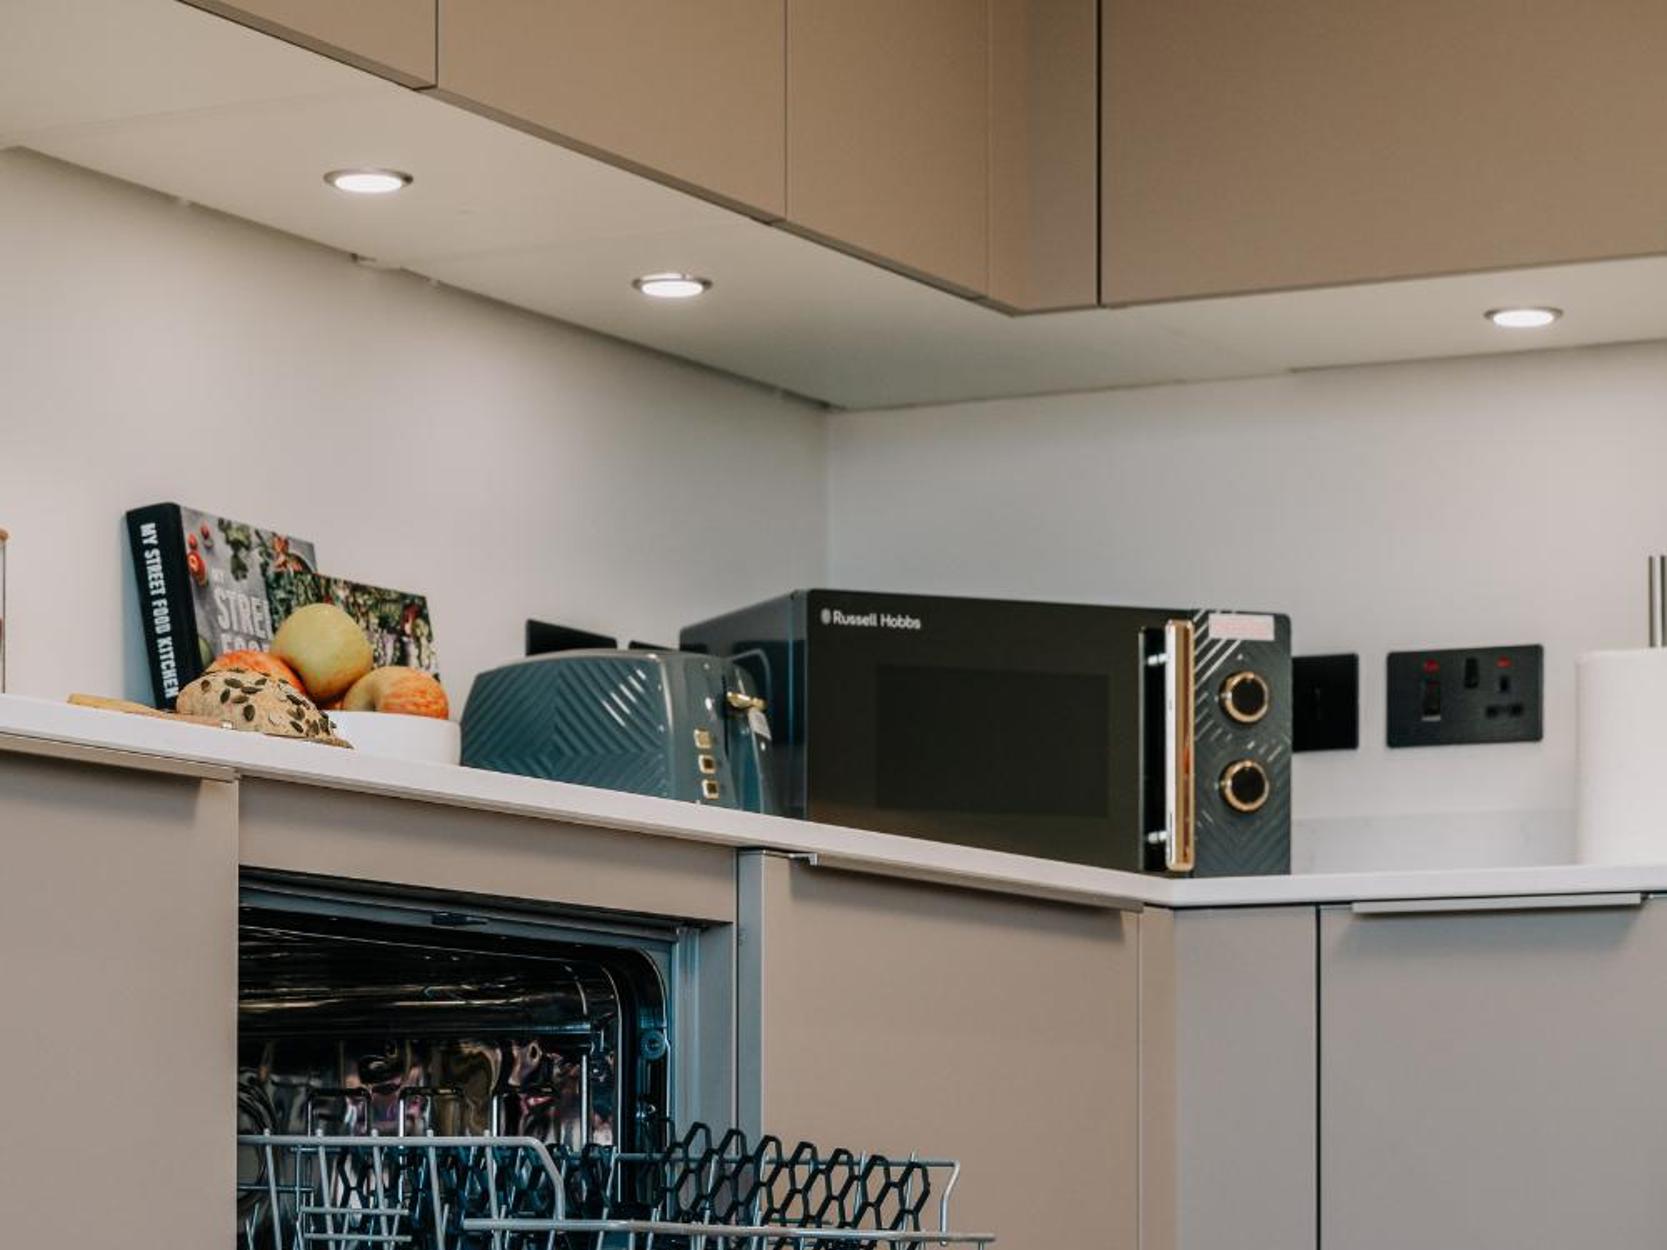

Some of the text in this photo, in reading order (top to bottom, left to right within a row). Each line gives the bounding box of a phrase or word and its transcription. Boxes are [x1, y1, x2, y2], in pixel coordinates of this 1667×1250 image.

[140, 522, 179, 698] MY STREET FOOD KITCHEN
[833, 610, 922, 630] Russell Hobbs
